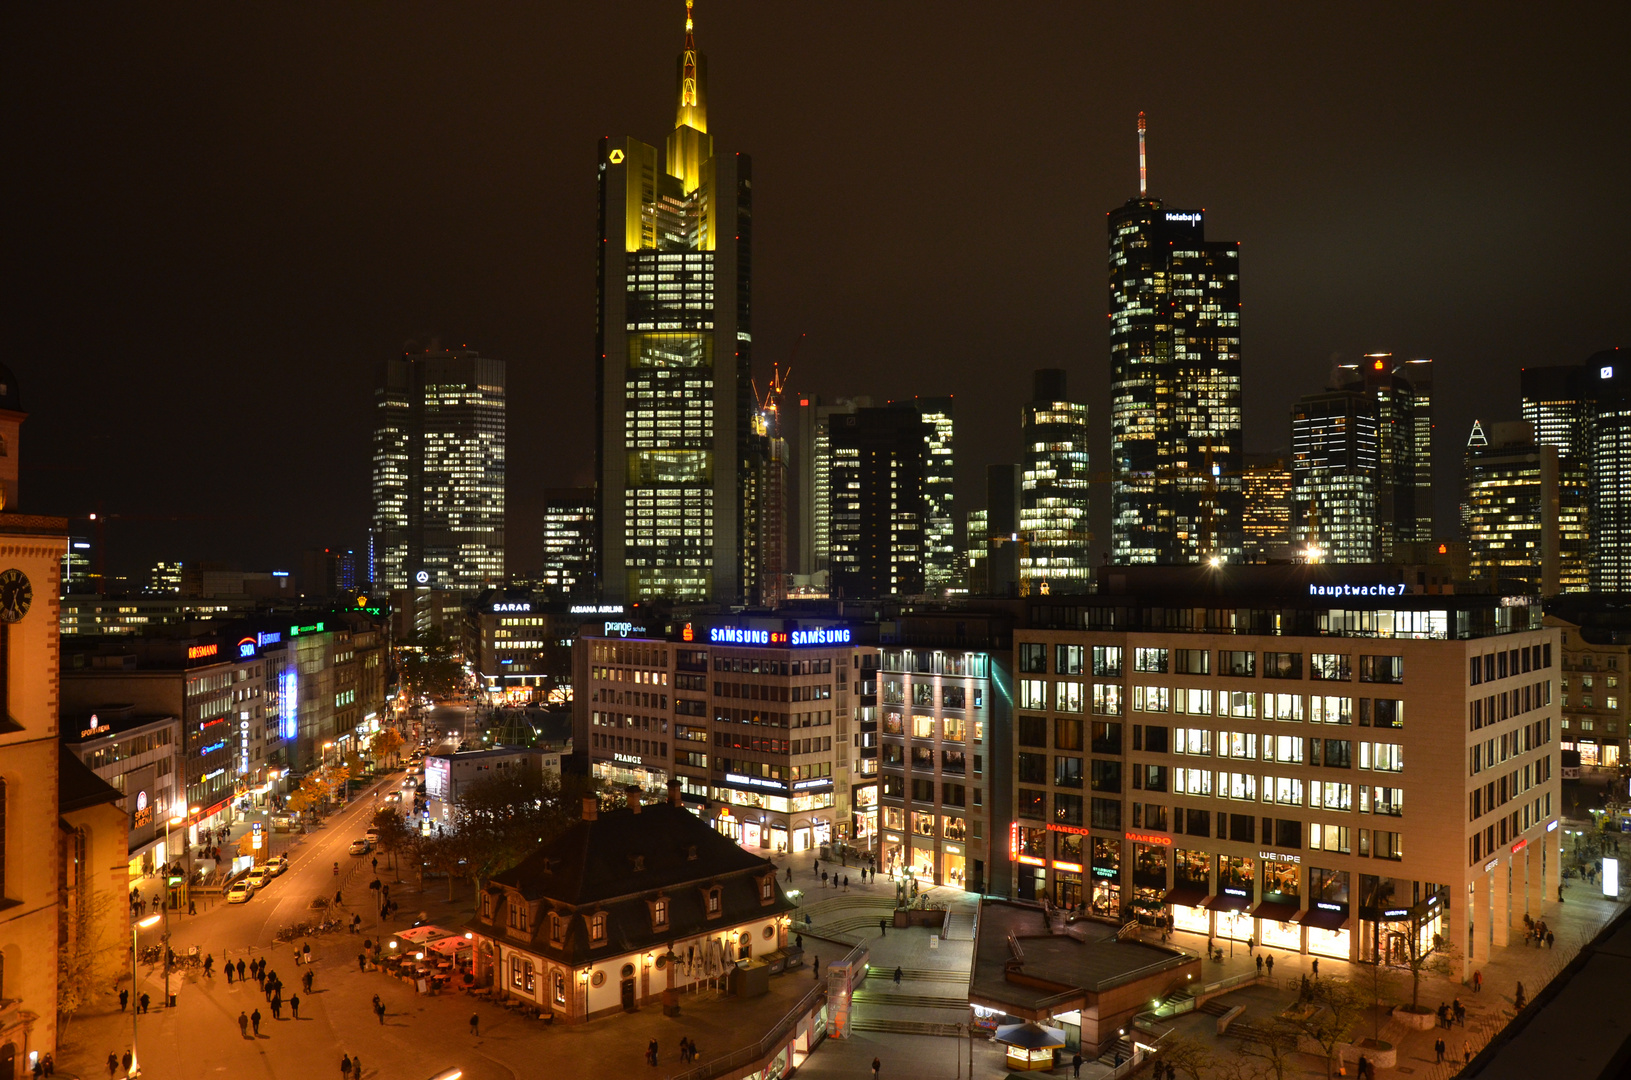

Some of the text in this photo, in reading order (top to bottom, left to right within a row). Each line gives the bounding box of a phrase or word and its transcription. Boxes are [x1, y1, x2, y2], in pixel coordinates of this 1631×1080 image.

[1165, 213, 1193, 221] Helaba
[1309, 583, 1406, 598] hauptwache 7
[493, 603, 531, 612] SARAR
[570, 605, 597, 614] ASIANA
[605, 621, 632, 638] prange
[710, 628, 767, 644] SAMSUNG
[790, 629, 849, 645] SAMSUNG
[188, 644, 218, 660] ROSSMANN
[614, 752, 642, 765] PRANGE
[134, 805, 153, 821] SPORT
[134, 814, 153, 830] ARENA
[1046, 823, 1089, 836] MAREDO
[1125, 832, 1172, 847] MAREDO
[1258, 851, 1301, 864] WEMPE
[1092, 866, 1117, 875] STARBUCKS
